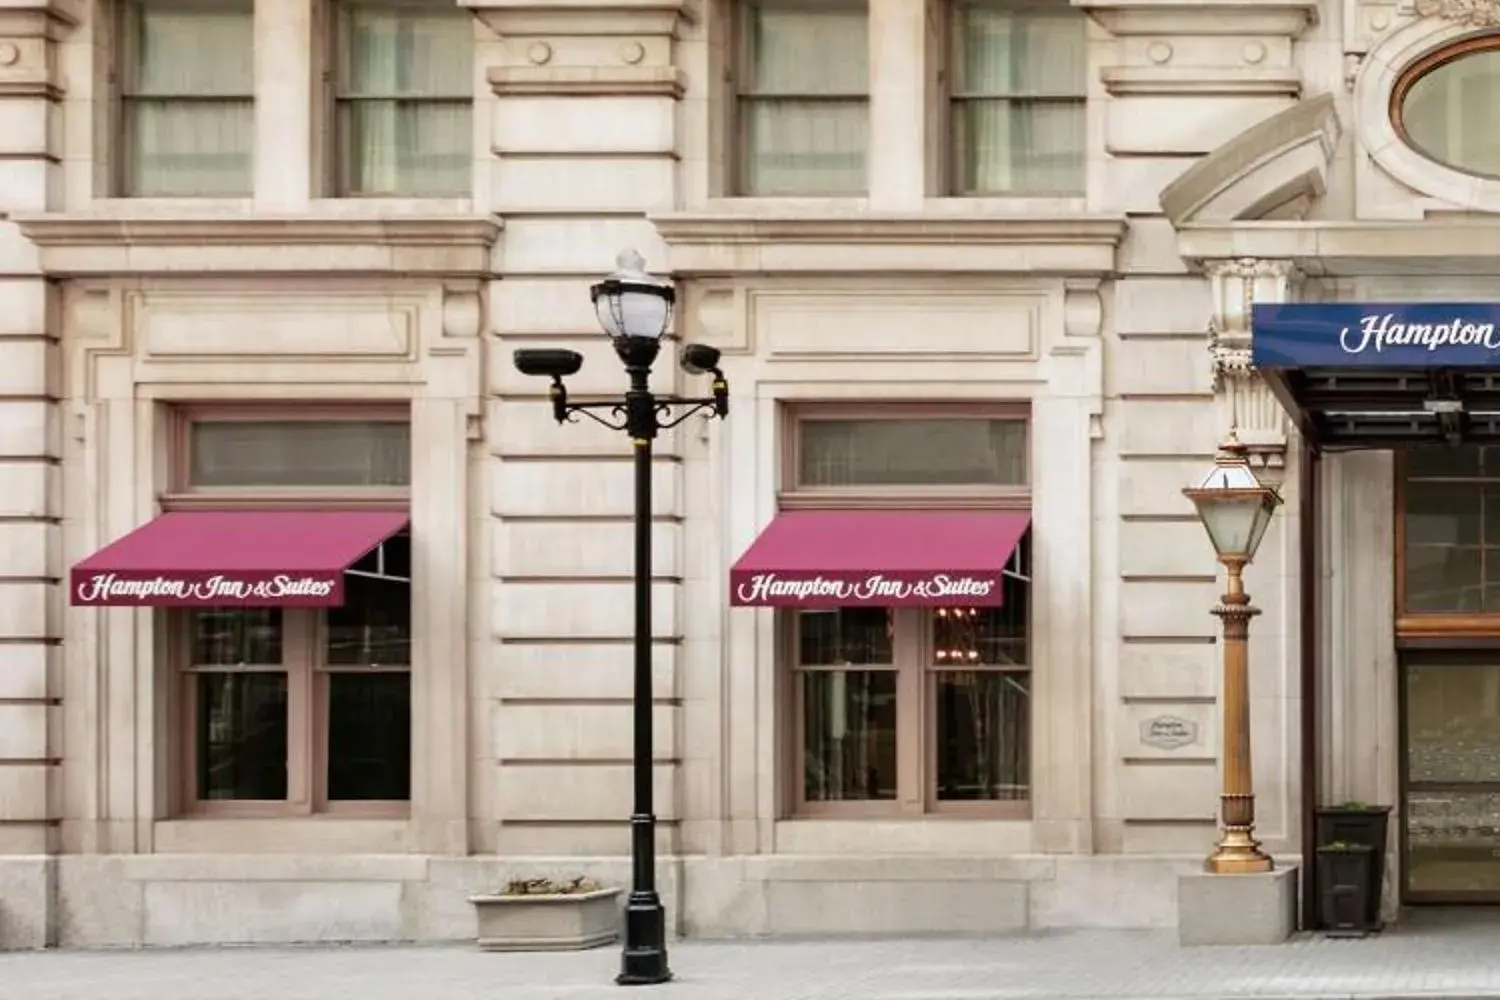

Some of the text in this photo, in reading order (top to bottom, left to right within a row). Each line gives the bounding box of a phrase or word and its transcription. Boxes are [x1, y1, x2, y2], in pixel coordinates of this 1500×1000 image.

[78, 573, 332, 601] Hampton Inn & Suites
[737, 573, 990, 601] Hampton Inn & Suites
